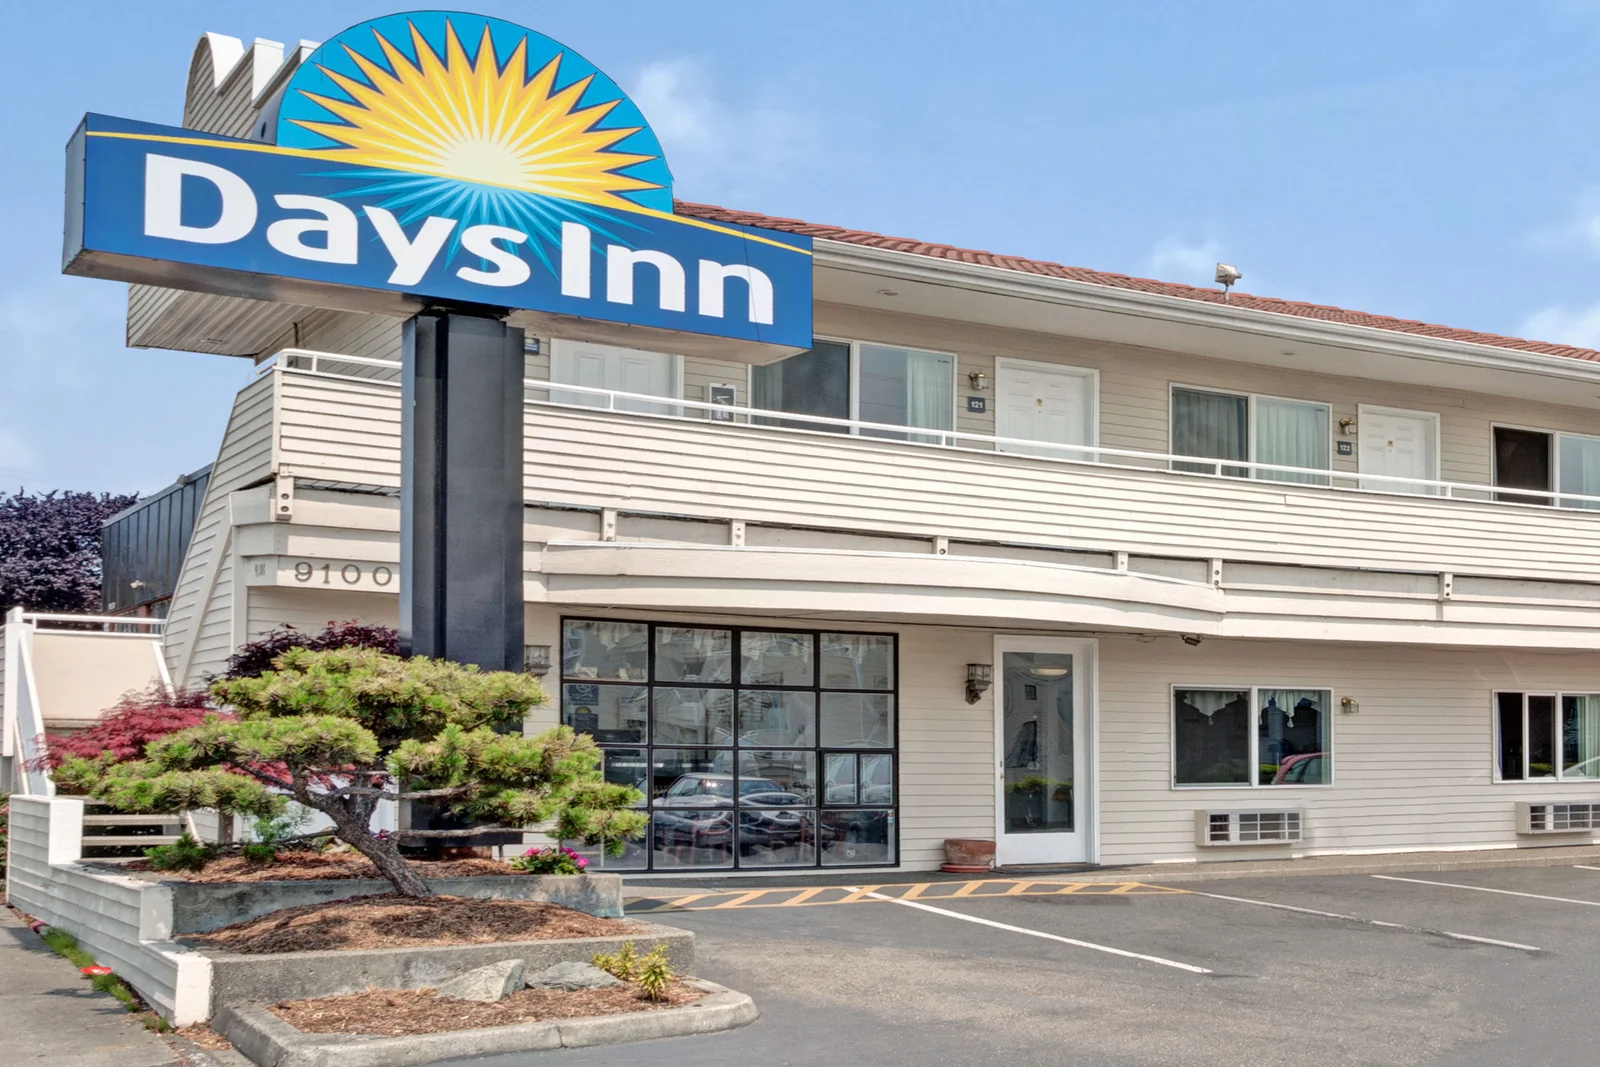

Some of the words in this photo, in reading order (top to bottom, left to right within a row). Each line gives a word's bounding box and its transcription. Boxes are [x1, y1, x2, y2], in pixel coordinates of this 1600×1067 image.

[144, 153, 531, 287] Days
[561, 221, 774, 326] Inn
[971, 401, 983, 409] 121
[1339, 444, 1351, 452] 122
[294, 561, 393, 587] 9100
